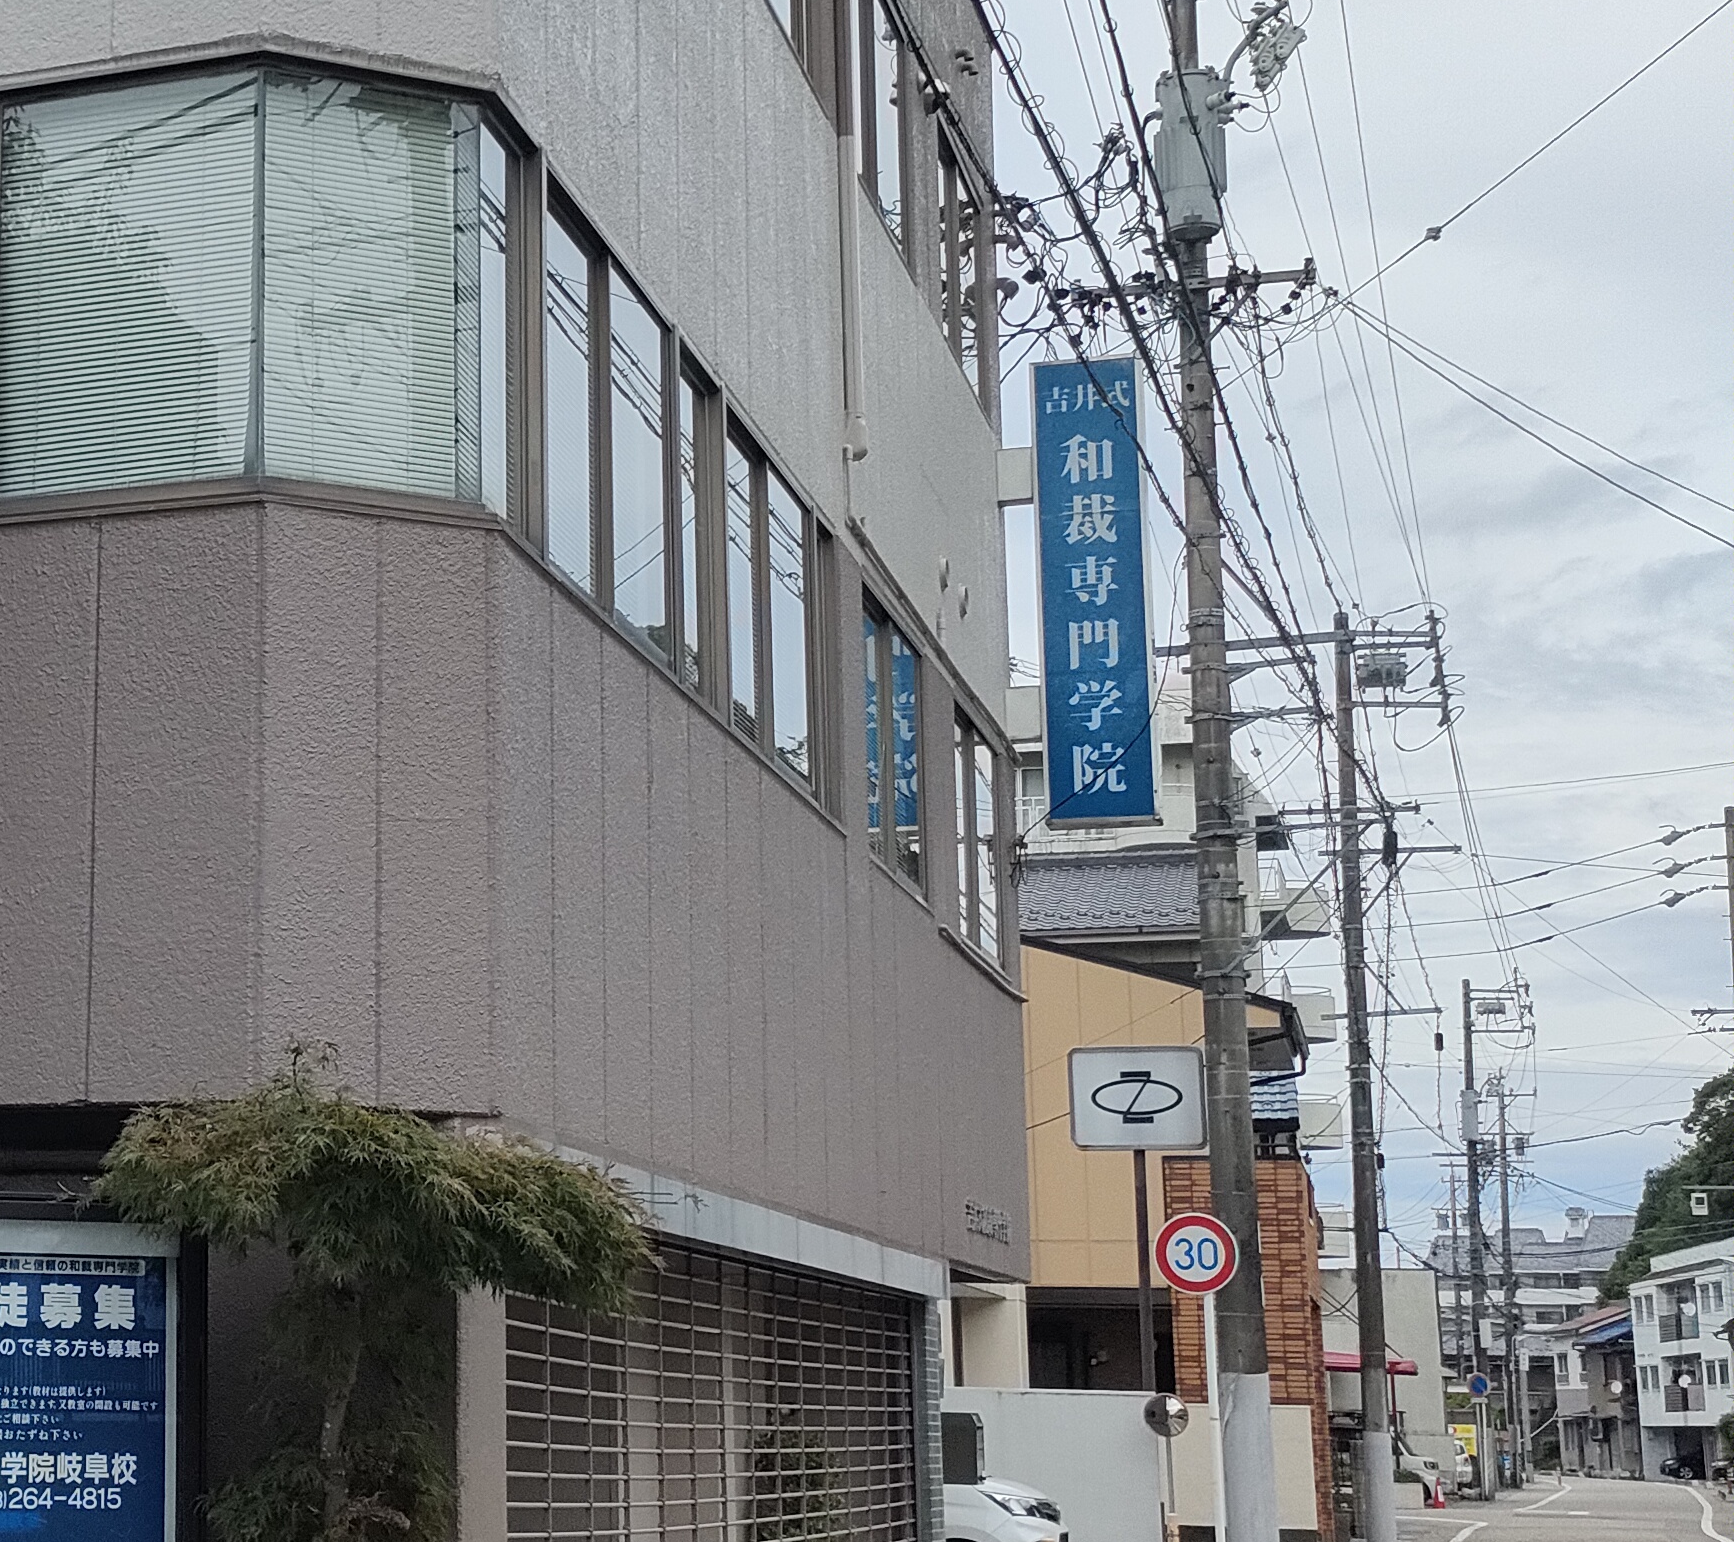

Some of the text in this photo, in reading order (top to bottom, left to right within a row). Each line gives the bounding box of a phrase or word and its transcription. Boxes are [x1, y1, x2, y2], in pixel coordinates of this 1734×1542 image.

[1042, 381, 1130, 414] 吉井式
[1059, 434, 1127, 795] 和裁専門学院
[1174, 1237, 1218, 1271] 30
